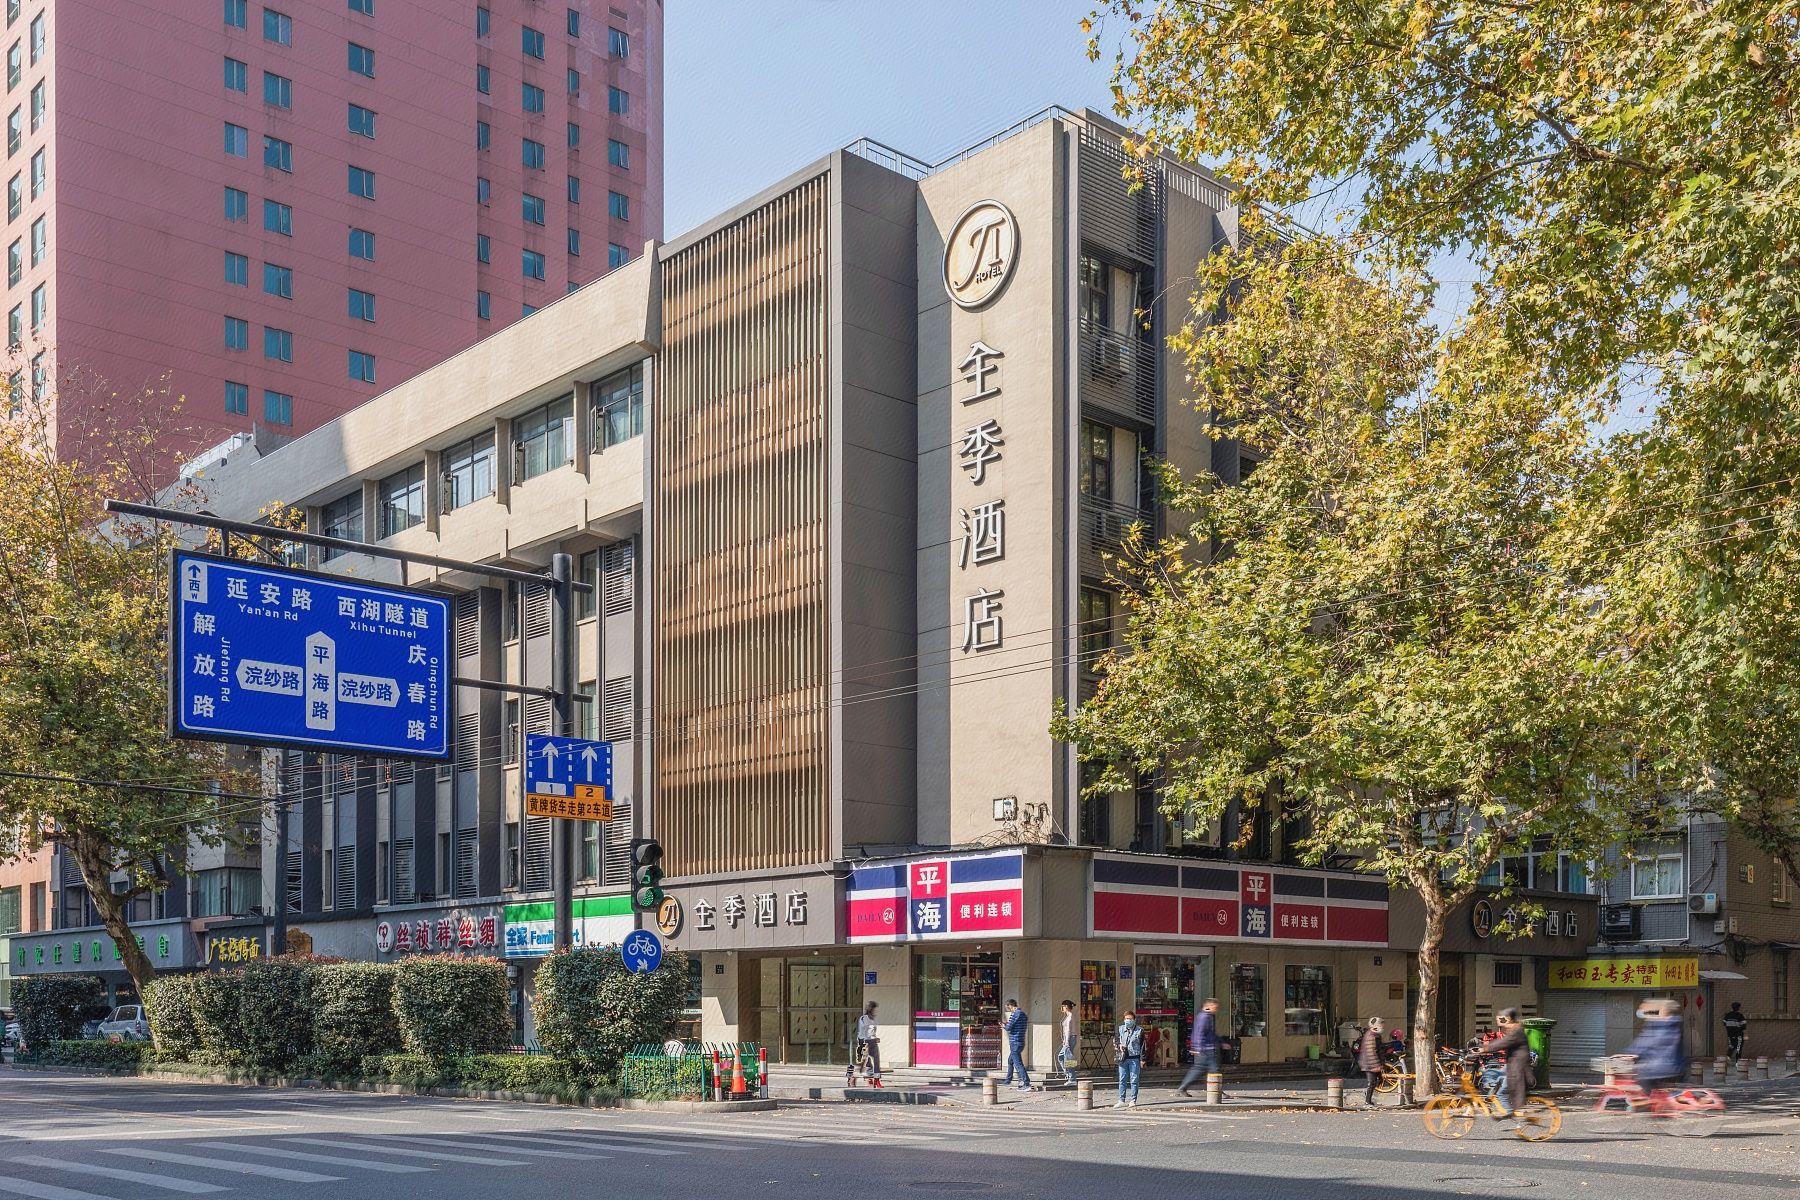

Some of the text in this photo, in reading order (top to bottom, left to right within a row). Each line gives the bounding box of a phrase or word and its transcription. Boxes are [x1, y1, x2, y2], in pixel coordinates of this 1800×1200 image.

[976, 265, 1003, 284] HOTEL
[957, 341, 1003, 652] 全季酒店
[188, 579, 200, 592] 西
[227, 577, 312, 611] 延安路
[238, 603, 298, 621] Yan'an Rd
[337, 596, 429, 629] 西湖隧道
[350, 621, 417, 639] Xihu Tunnel
[193, 612, 216, 718] 解放路
[219, 637, 231, 702] Jiefang Rd
[244, 666, 300, 691] 浣纱路
[312, 645, 330, 720] 平海路
[341, 679, 393, 702] 浣纱路
[407, 645, 427, 741] 庆春路
[429, 715, 438, 729] Rd
[585, 788, 594, 797] 2
[529, 797, 611, 818] 黄牌货车走第2车道
[693, 890, 805, 928] 全季酒店
[917, 866, 941, 930] 平海
[1246, 875, 1267, 934] 平海
[960, 902, 1013, 919] 便利连锁
[1280, 914, 1319, 929] 便利连锁
[1501, 908, 1578, 937] 全酒店
[506, 927, 527, 946] 全家
[1641, 975, 1652, 985] 店
